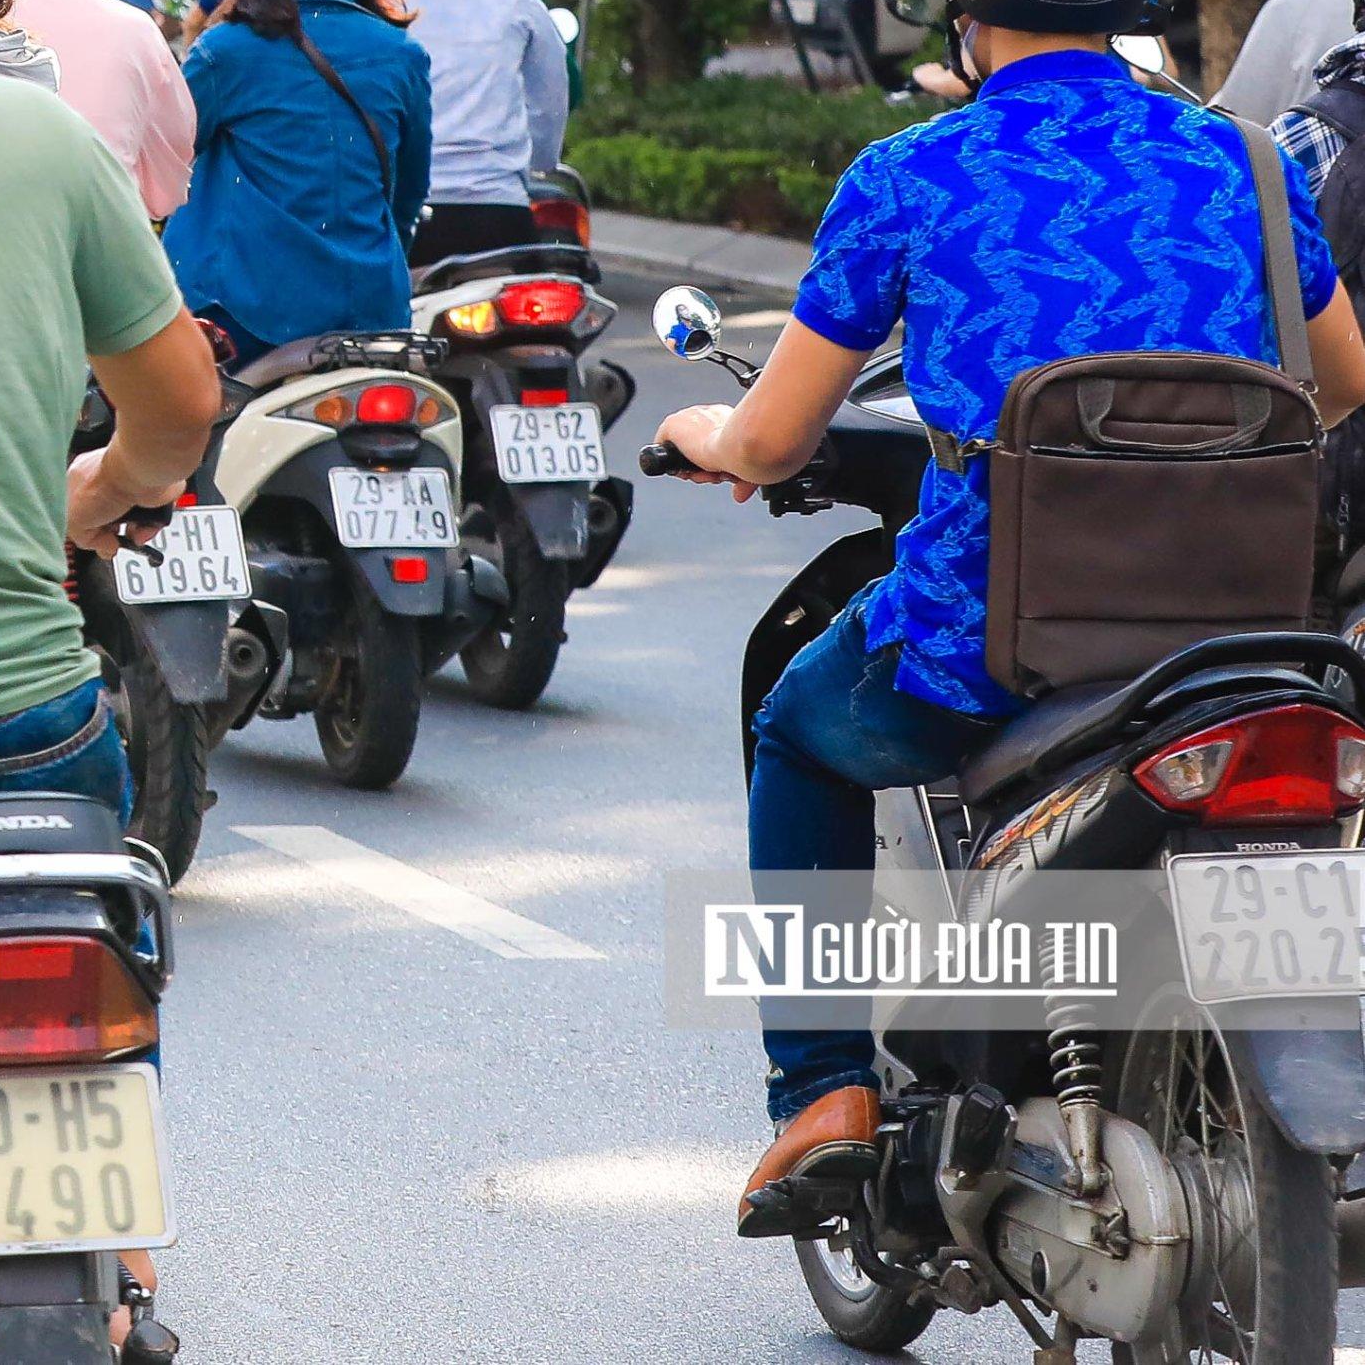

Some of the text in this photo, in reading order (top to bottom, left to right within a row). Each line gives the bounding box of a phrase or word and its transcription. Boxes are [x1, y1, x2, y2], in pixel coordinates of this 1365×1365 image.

[510, 411, 586, 441] 29-G2
[506, 445, 599, 475] 013.05
[350, 476, 433, 505] 29-AA
[347, 510, 447, 539] 077.49
[124, 555, 239, 595] 619.64
[1235, 841, 1302, 852] HONDA
[1202, 860, 1356, 923] 29-C1
[1196, 927, 1365, 986] 220.2
